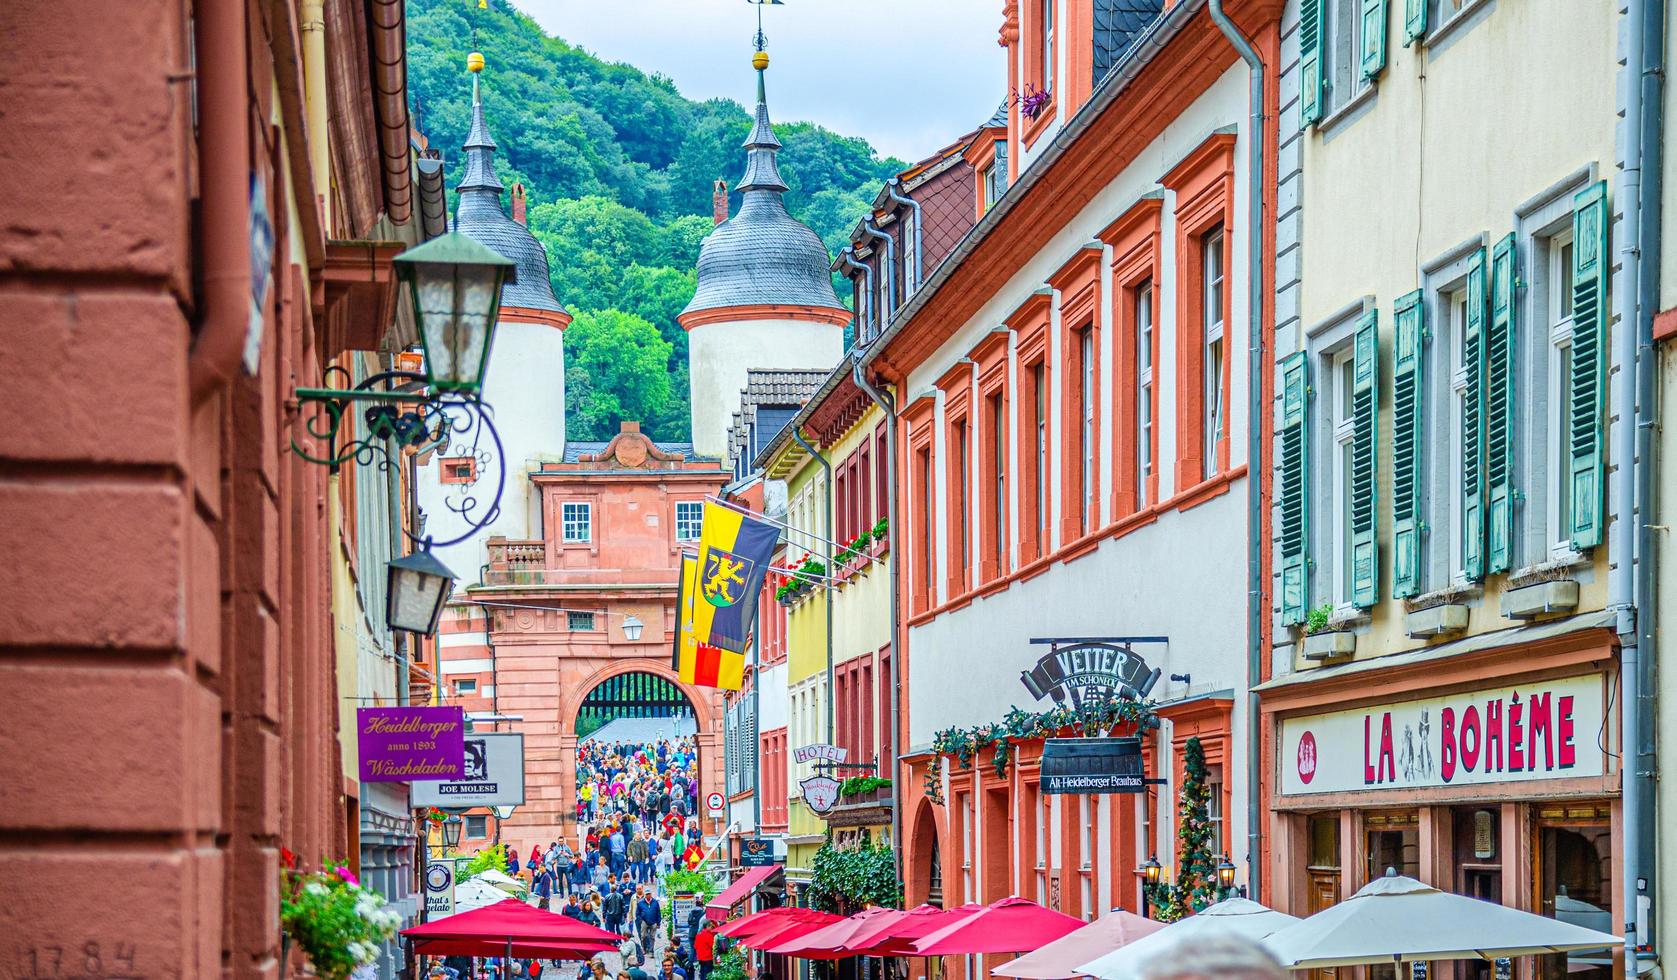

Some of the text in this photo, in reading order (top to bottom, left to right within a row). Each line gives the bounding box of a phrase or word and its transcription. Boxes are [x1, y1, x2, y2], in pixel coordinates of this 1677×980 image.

[1055, 648, 1128, 679] VETTER
[364, 715, 458, 739] Heidelberger
[387, 743, 410, 752] anno
[797, 746, 843, 761] HOTEL
[1364, 711, 1396, 785] LA
[366, 757, 458, 776] Wäscheladen
[440, 784, 496, 793] JOE MOLESE
[1049, 775, 1143, 789] Alt-Heidelberger Brauhaus
[426, 903, 450, 914] gelato
